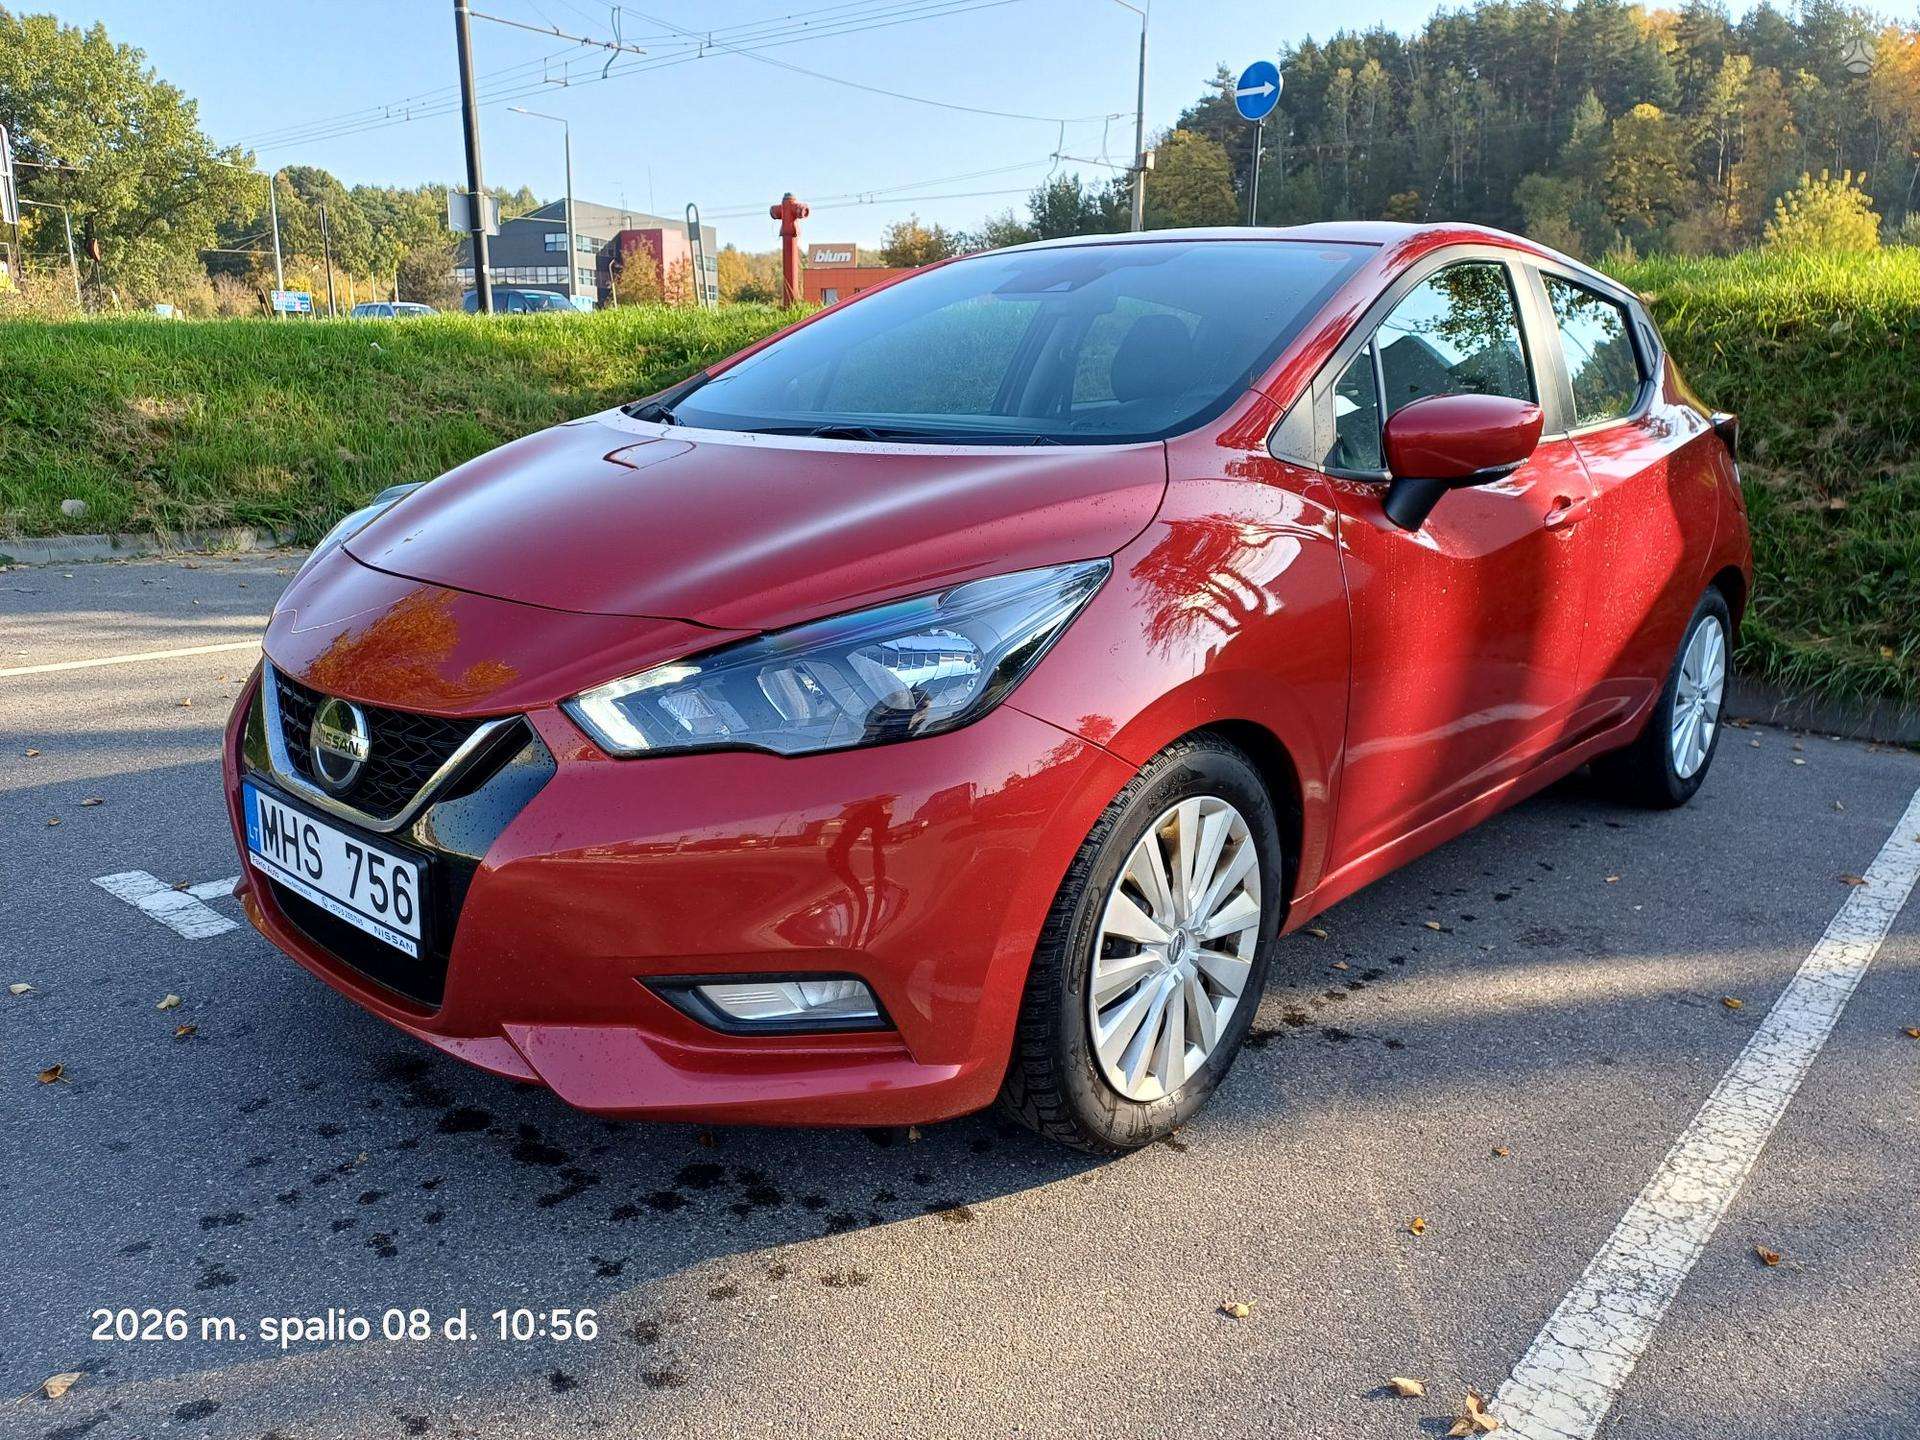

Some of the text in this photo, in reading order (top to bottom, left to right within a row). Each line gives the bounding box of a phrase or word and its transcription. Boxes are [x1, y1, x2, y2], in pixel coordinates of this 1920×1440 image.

[814, 249, 852, 263] blum
[259, 797, 414, 926] MHS 756
[373, 925, 414, 954] NISSAN
